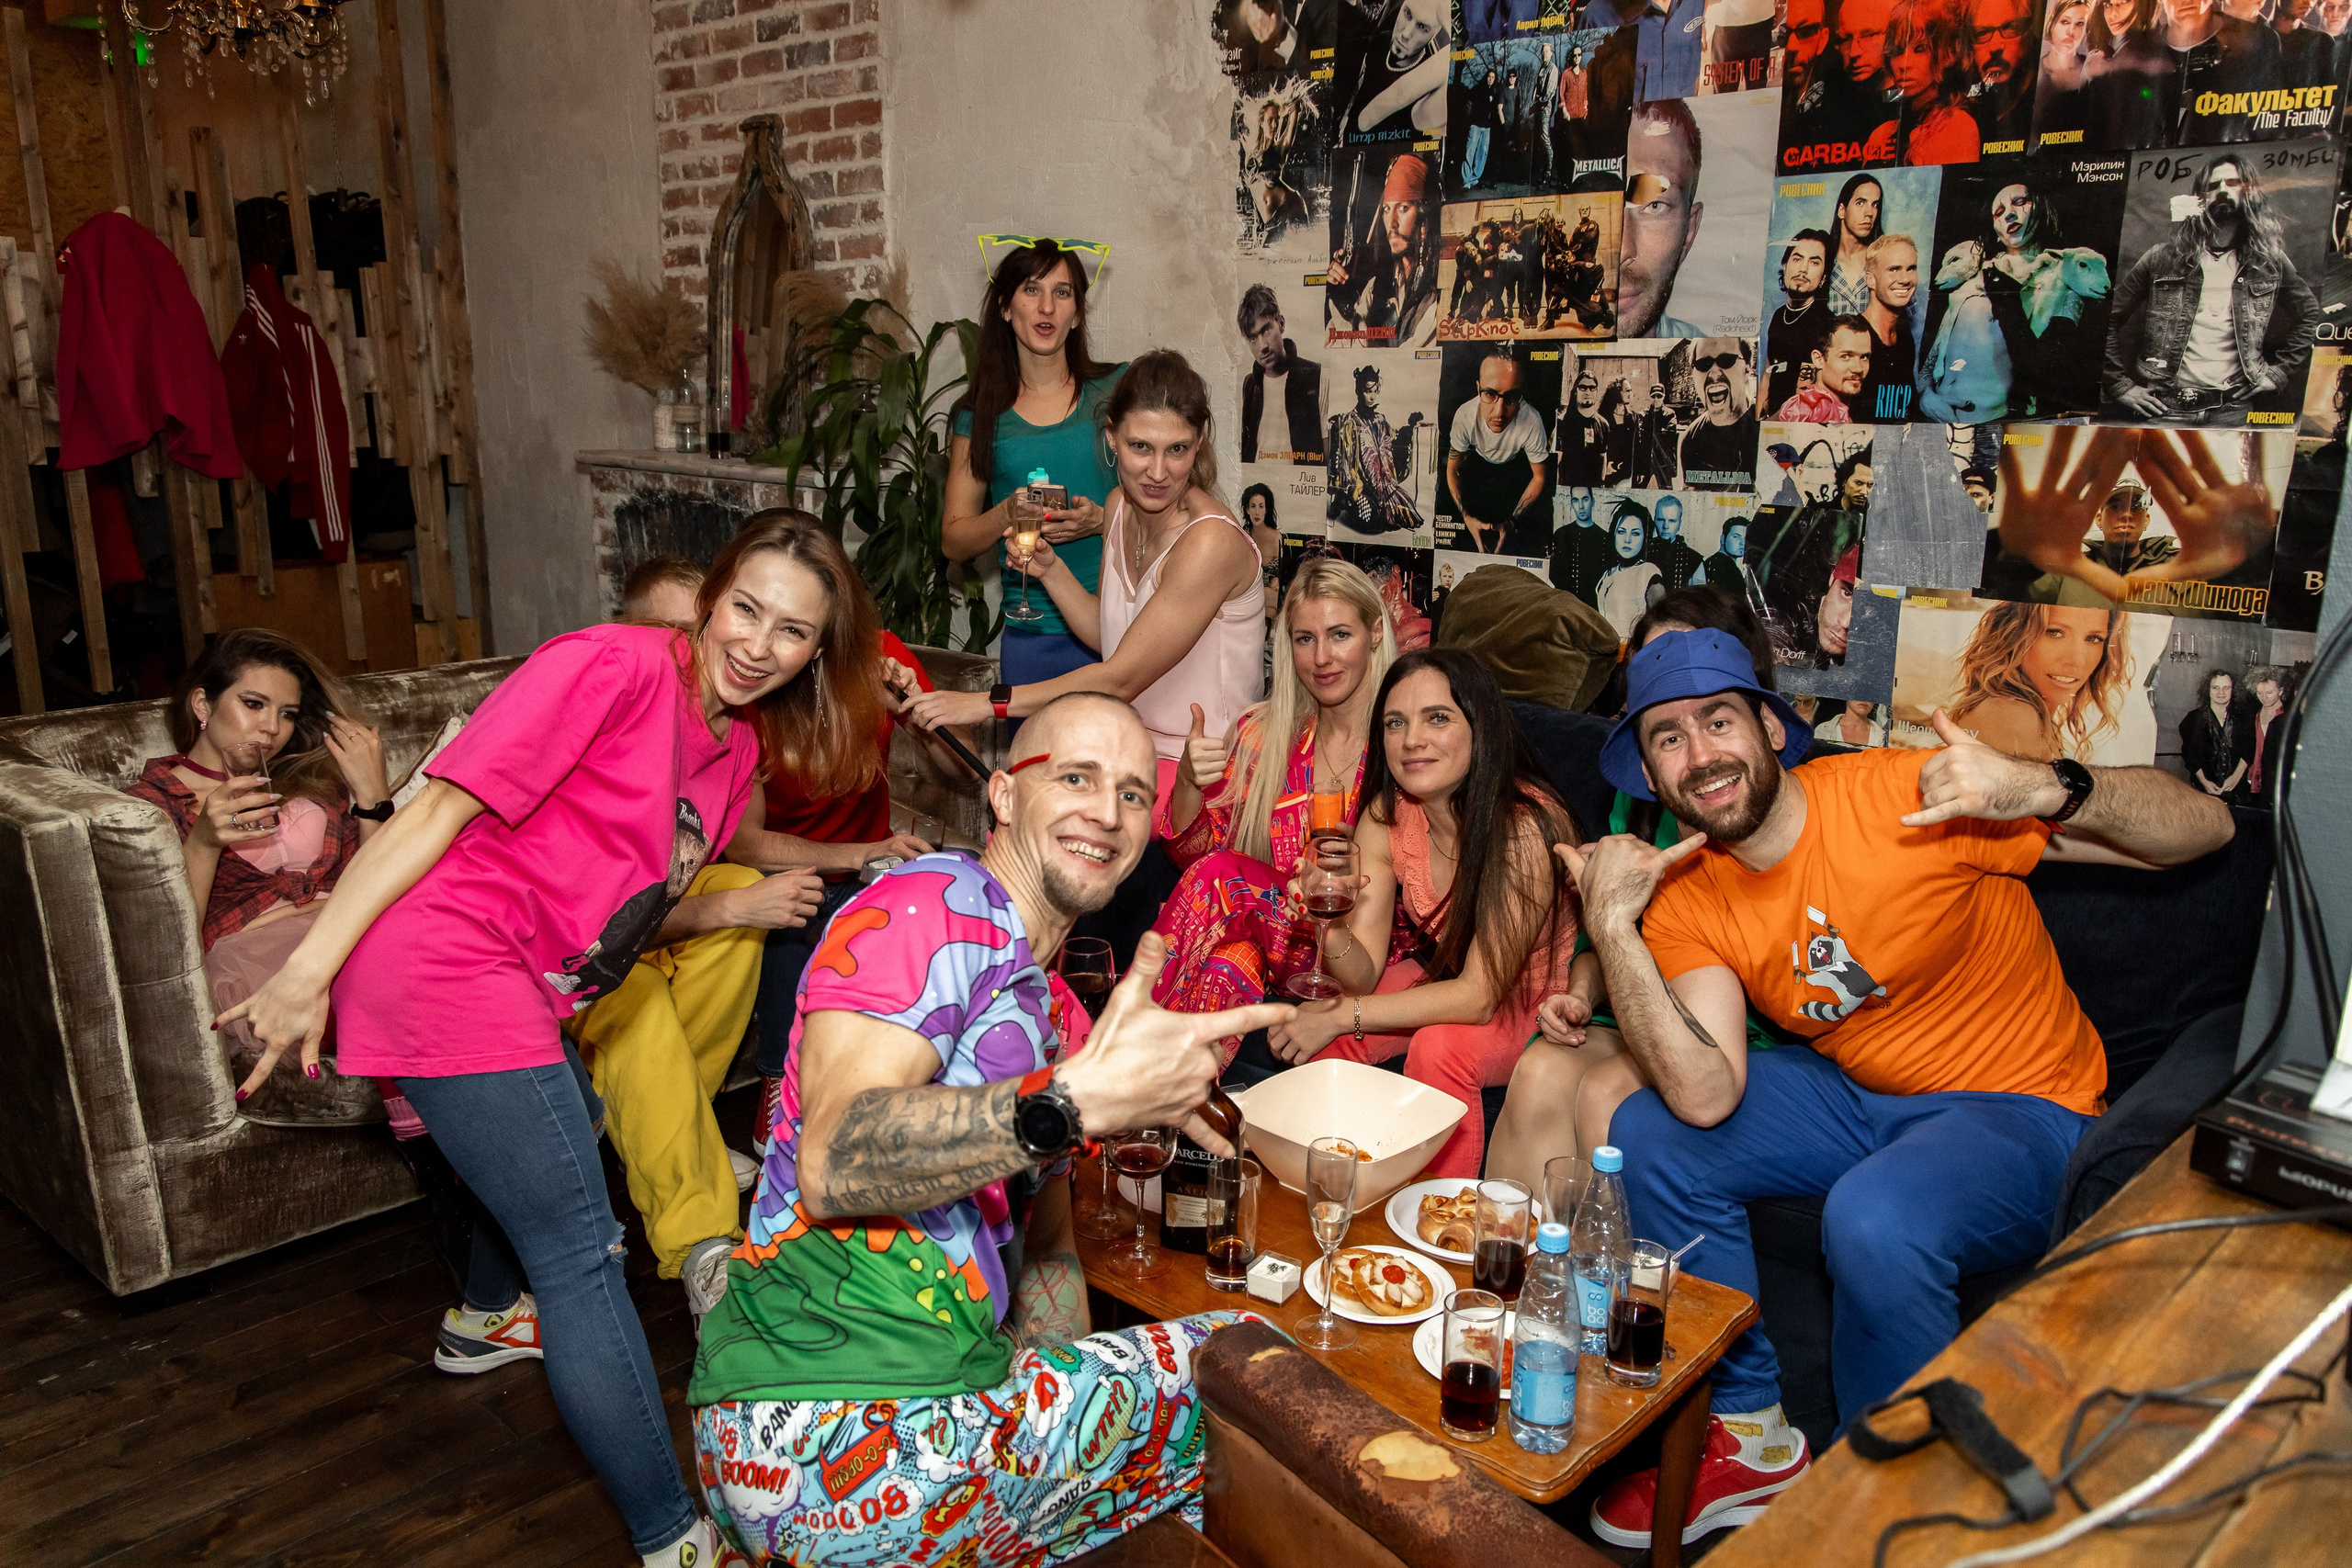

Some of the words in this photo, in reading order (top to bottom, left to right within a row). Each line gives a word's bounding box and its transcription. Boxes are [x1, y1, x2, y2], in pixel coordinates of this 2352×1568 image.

[1516, 19, 1539, 30] Аврил
[1703, 59, 1746, 86] SYSTEM
[1749, 57, 1765, 81] OF
[2195, 85, 2338, 117] Факультет
[2253, 111, 2280, 130] /The
[2284, 106, 2335, 127] Faculty/
[1349, 132, 1375, 144] Limp
[2040, 130, 2085, 145] РОВЕСНИК
[1783, 140, 1896, 167] GARBAGE
[1983, 140, 2025, 154] РОВЕСНИК
[1572, 154, 1625, 182] METALLICA
[2071, 160, 2125, 173] Мэрилин
[2135, 152, 2205, 184] РОБ
[2076, 172, 2124, 184] Мэнсон
[1780, 182, 1826, 197] РОВЕСНИК
[1720, 316, 1736, 324] Том
[1713, 323, 1758, 335] (Radiohead)
[1875, 384, 1912, 418] RHCP
[2246, 412, 2295, 424] РОВЕСНИК
[2003, 434, 2044, 446] РОВЕСНИК
[1258, 450, 1278, 461] Дэмон
[1279, 450, 1306, 462] ЭЛБАРН
[1306, 451, 1324, 462] (Blur)
[1299, 471, 1317, 483] Лив
[1685, 469, 1752, 485] METALLICA
[1290, 482, 1326, 497] ТАЙЛЕР
[1516, 558, 1544, 569] РОВЕСНИК
[1911, 595, 1948, 608] РОВЕСНИК
[2125, 577, 2183, 607] Майк
[2183, 580, 2270, 616] Шинода
[1781, 648, 1806, 660] Dorff
[1082, 1380, 1128, 1463] WTF!?
[829, 1435, 892, 1493] O-O-OPS!!!
[720, 1460, 791, 1495] BOOM!
